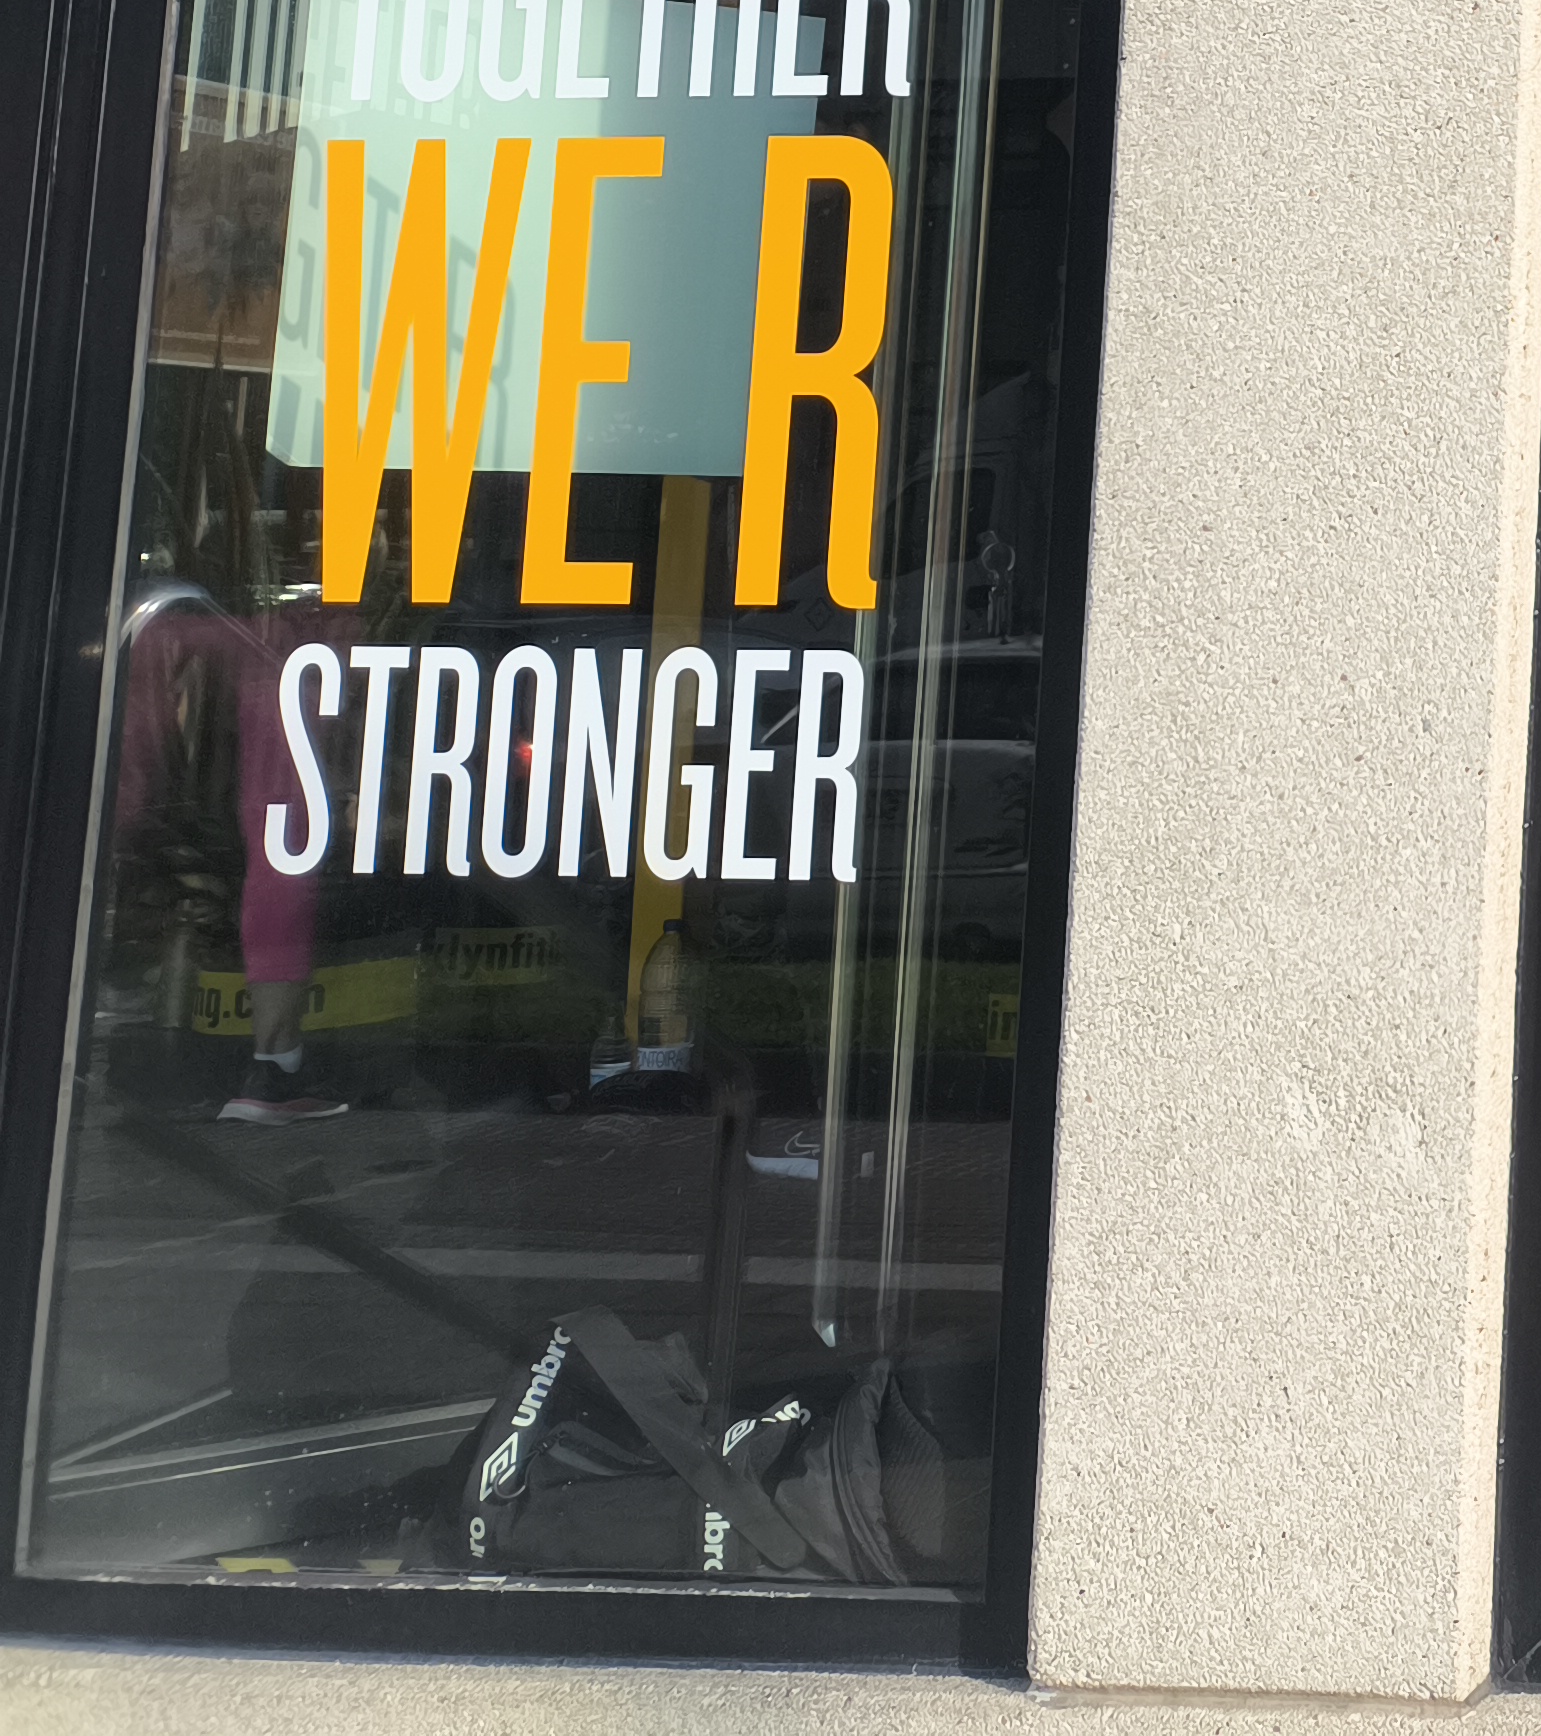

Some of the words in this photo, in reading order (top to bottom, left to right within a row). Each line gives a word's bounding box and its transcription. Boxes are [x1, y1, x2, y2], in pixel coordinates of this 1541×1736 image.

[320, 135, 666, 606] WE
[733, 135, 893, 611] R
[264, 642, 866, 884] STRONGER
